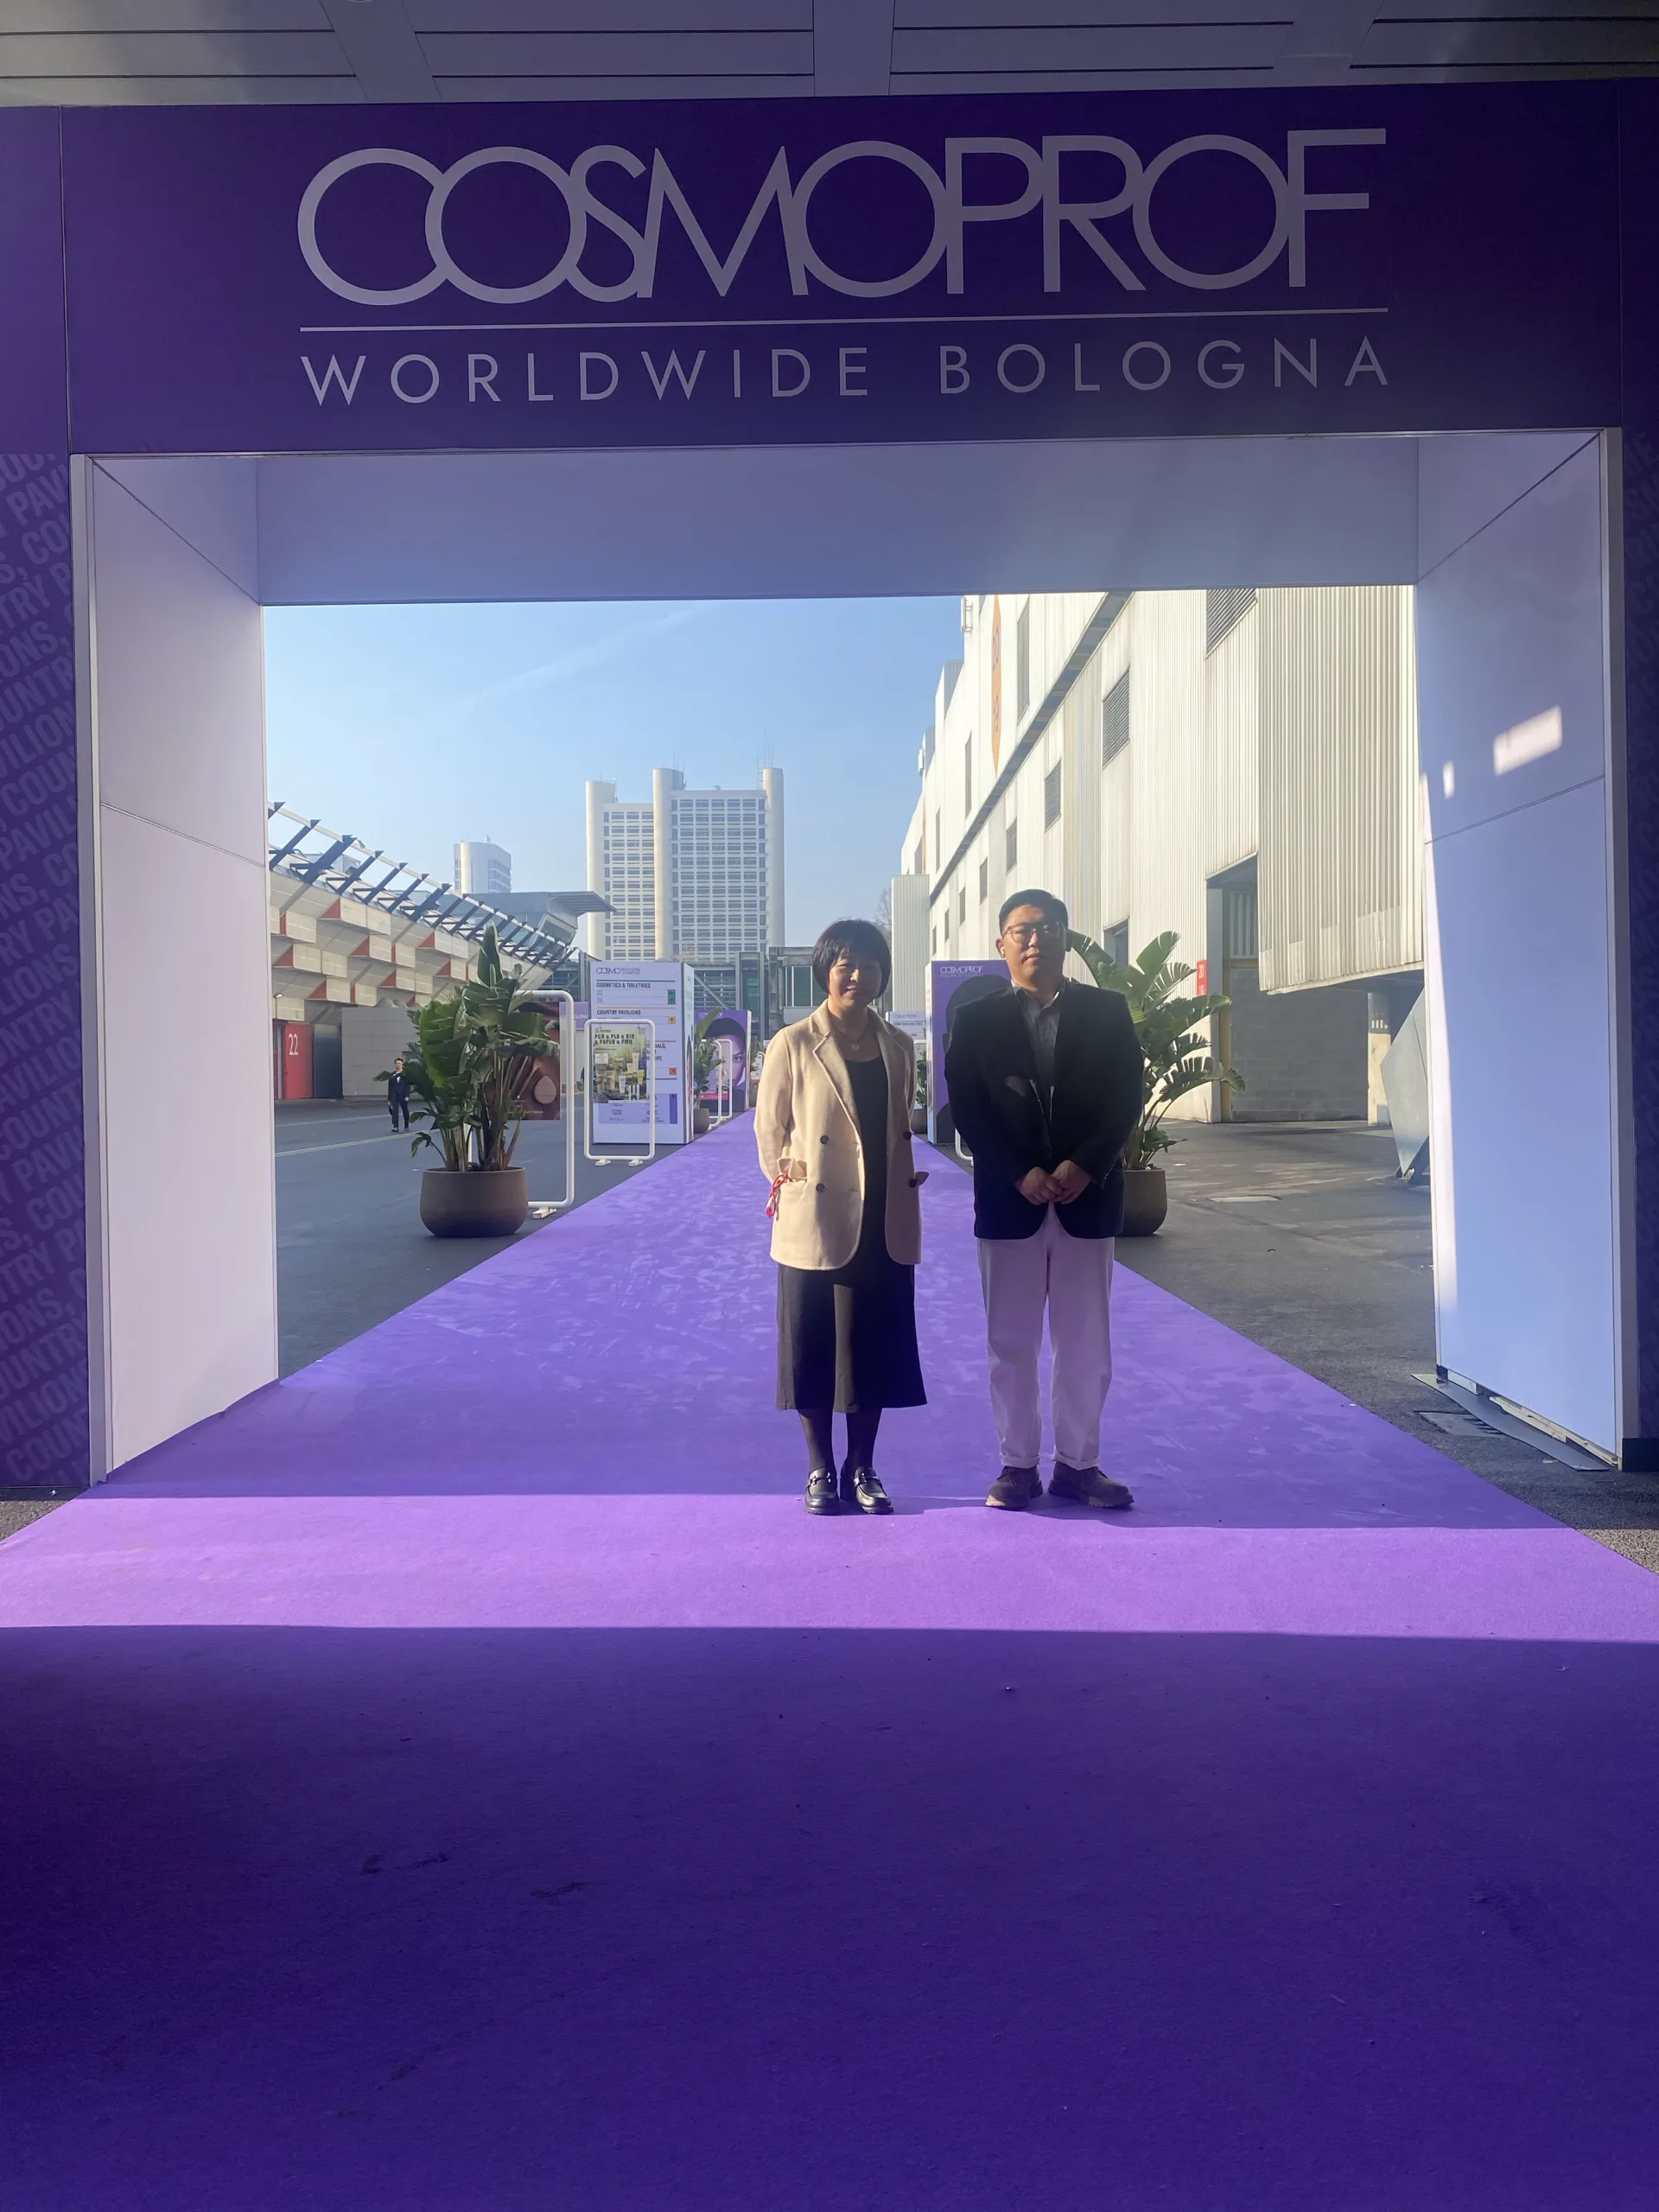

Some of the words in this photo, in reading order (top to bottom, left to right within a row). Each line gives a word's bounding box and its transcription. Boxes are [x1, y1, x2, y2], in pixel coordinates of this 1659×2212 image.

[297, 128, 1387, 307] COSMOPROF
[300, 347, 868, 406] WORLDWIDE
[939, 334, 1389, 394] BOLOGNA
[1199, 964, 1204, 978] 20
[289, 1033, 298, 1055] 22
